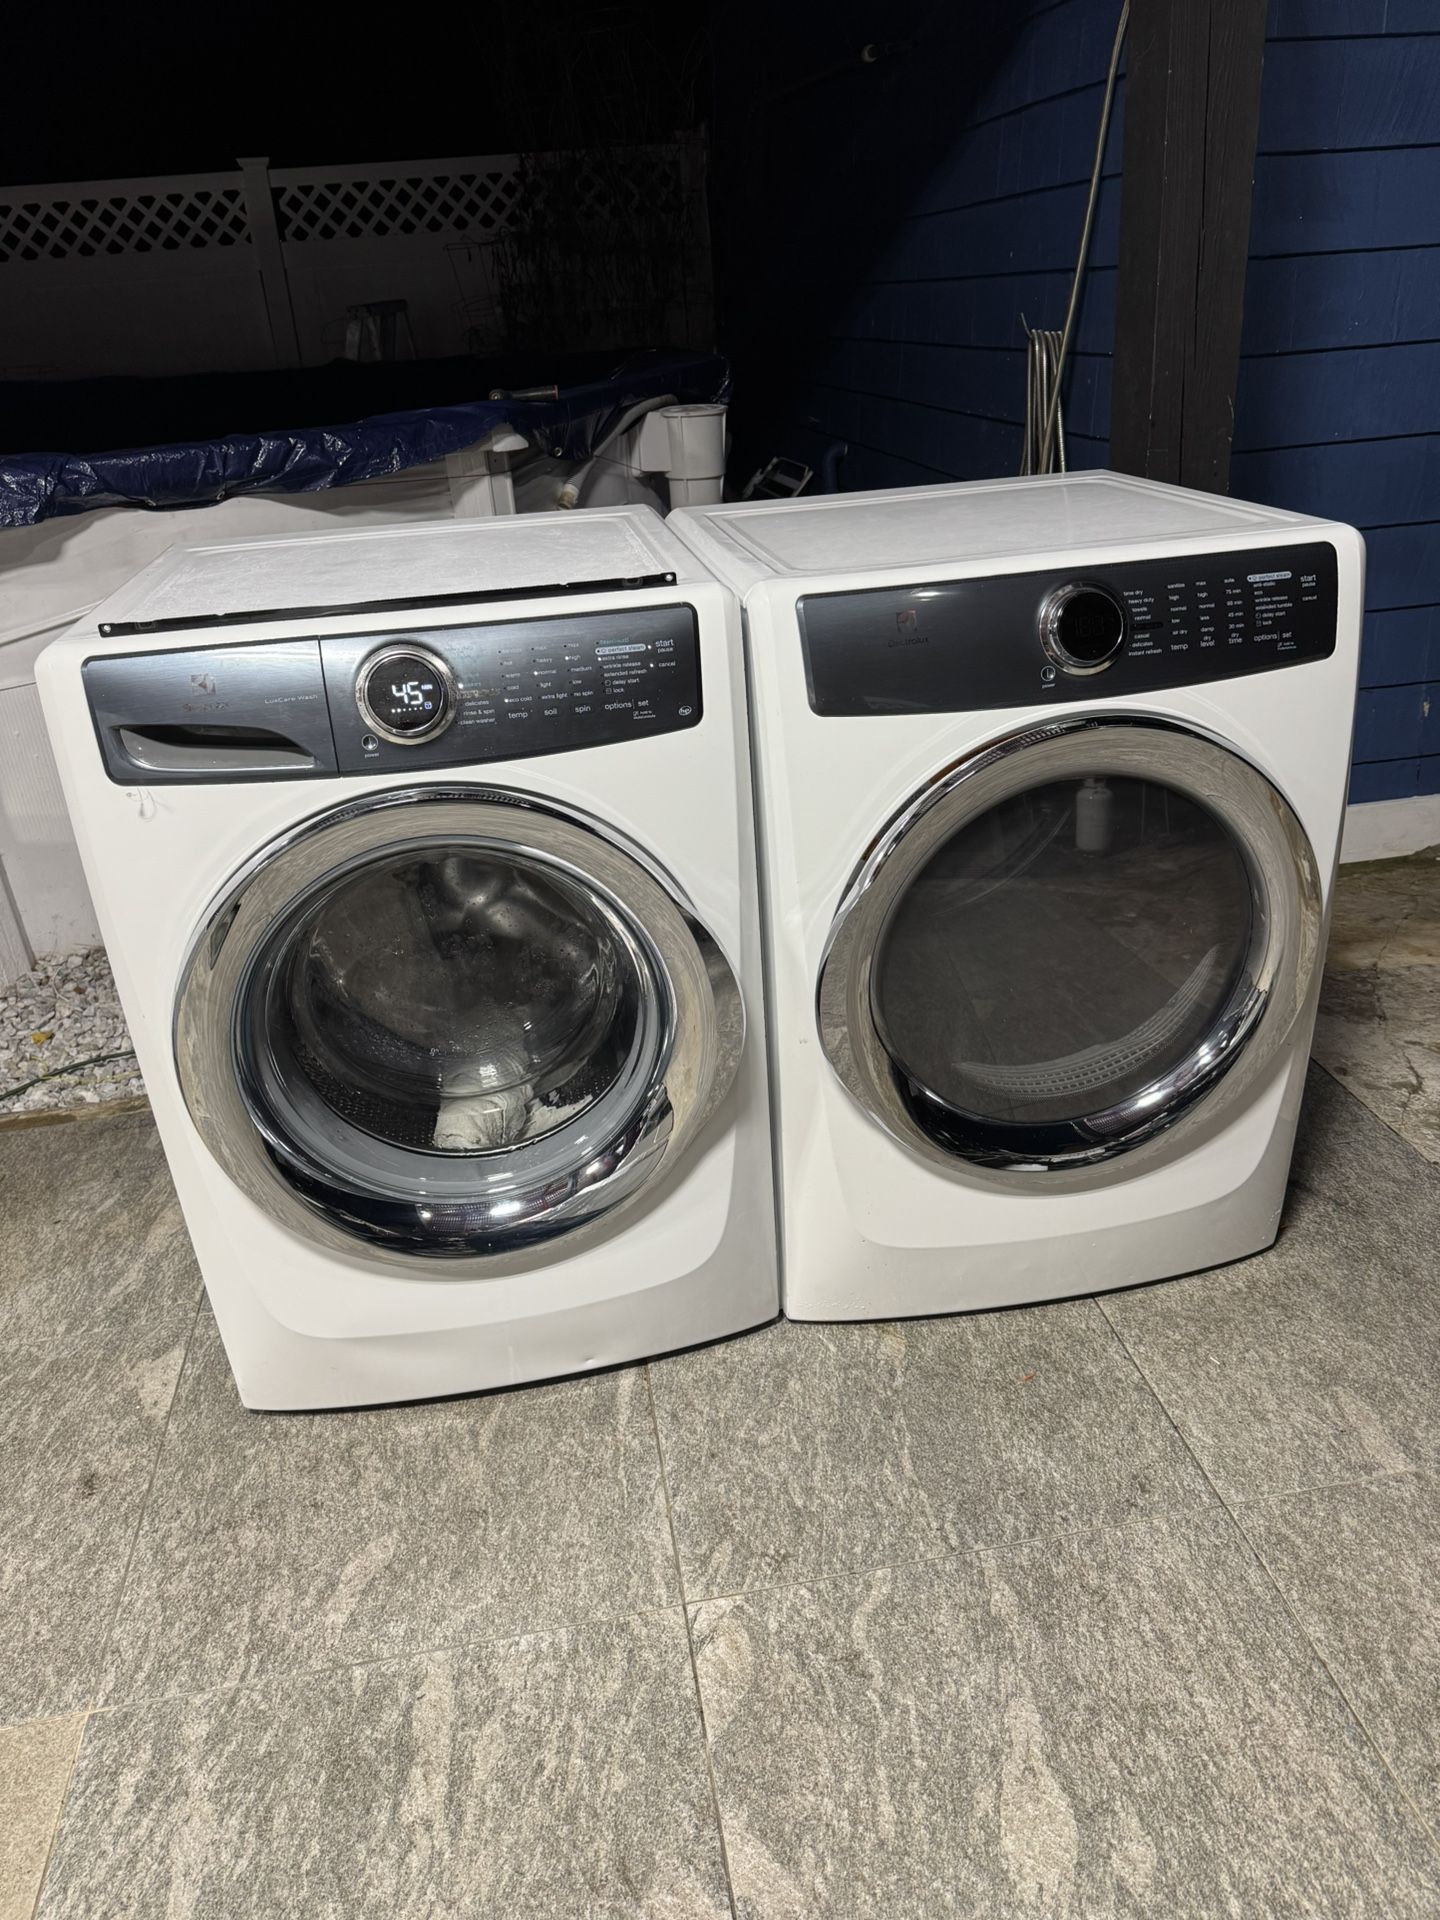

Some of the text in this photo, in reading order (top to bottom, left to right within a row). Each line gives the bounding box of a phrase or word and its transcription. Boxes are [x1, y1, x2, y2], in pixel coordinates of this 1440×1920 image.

[1254, 633, 1277, 641] options
[656, 639, 674, 648] start
[392, 682, 423, 705] 45
[575, 705, 591, 713] spin
[604, 702, 632, 711] options
